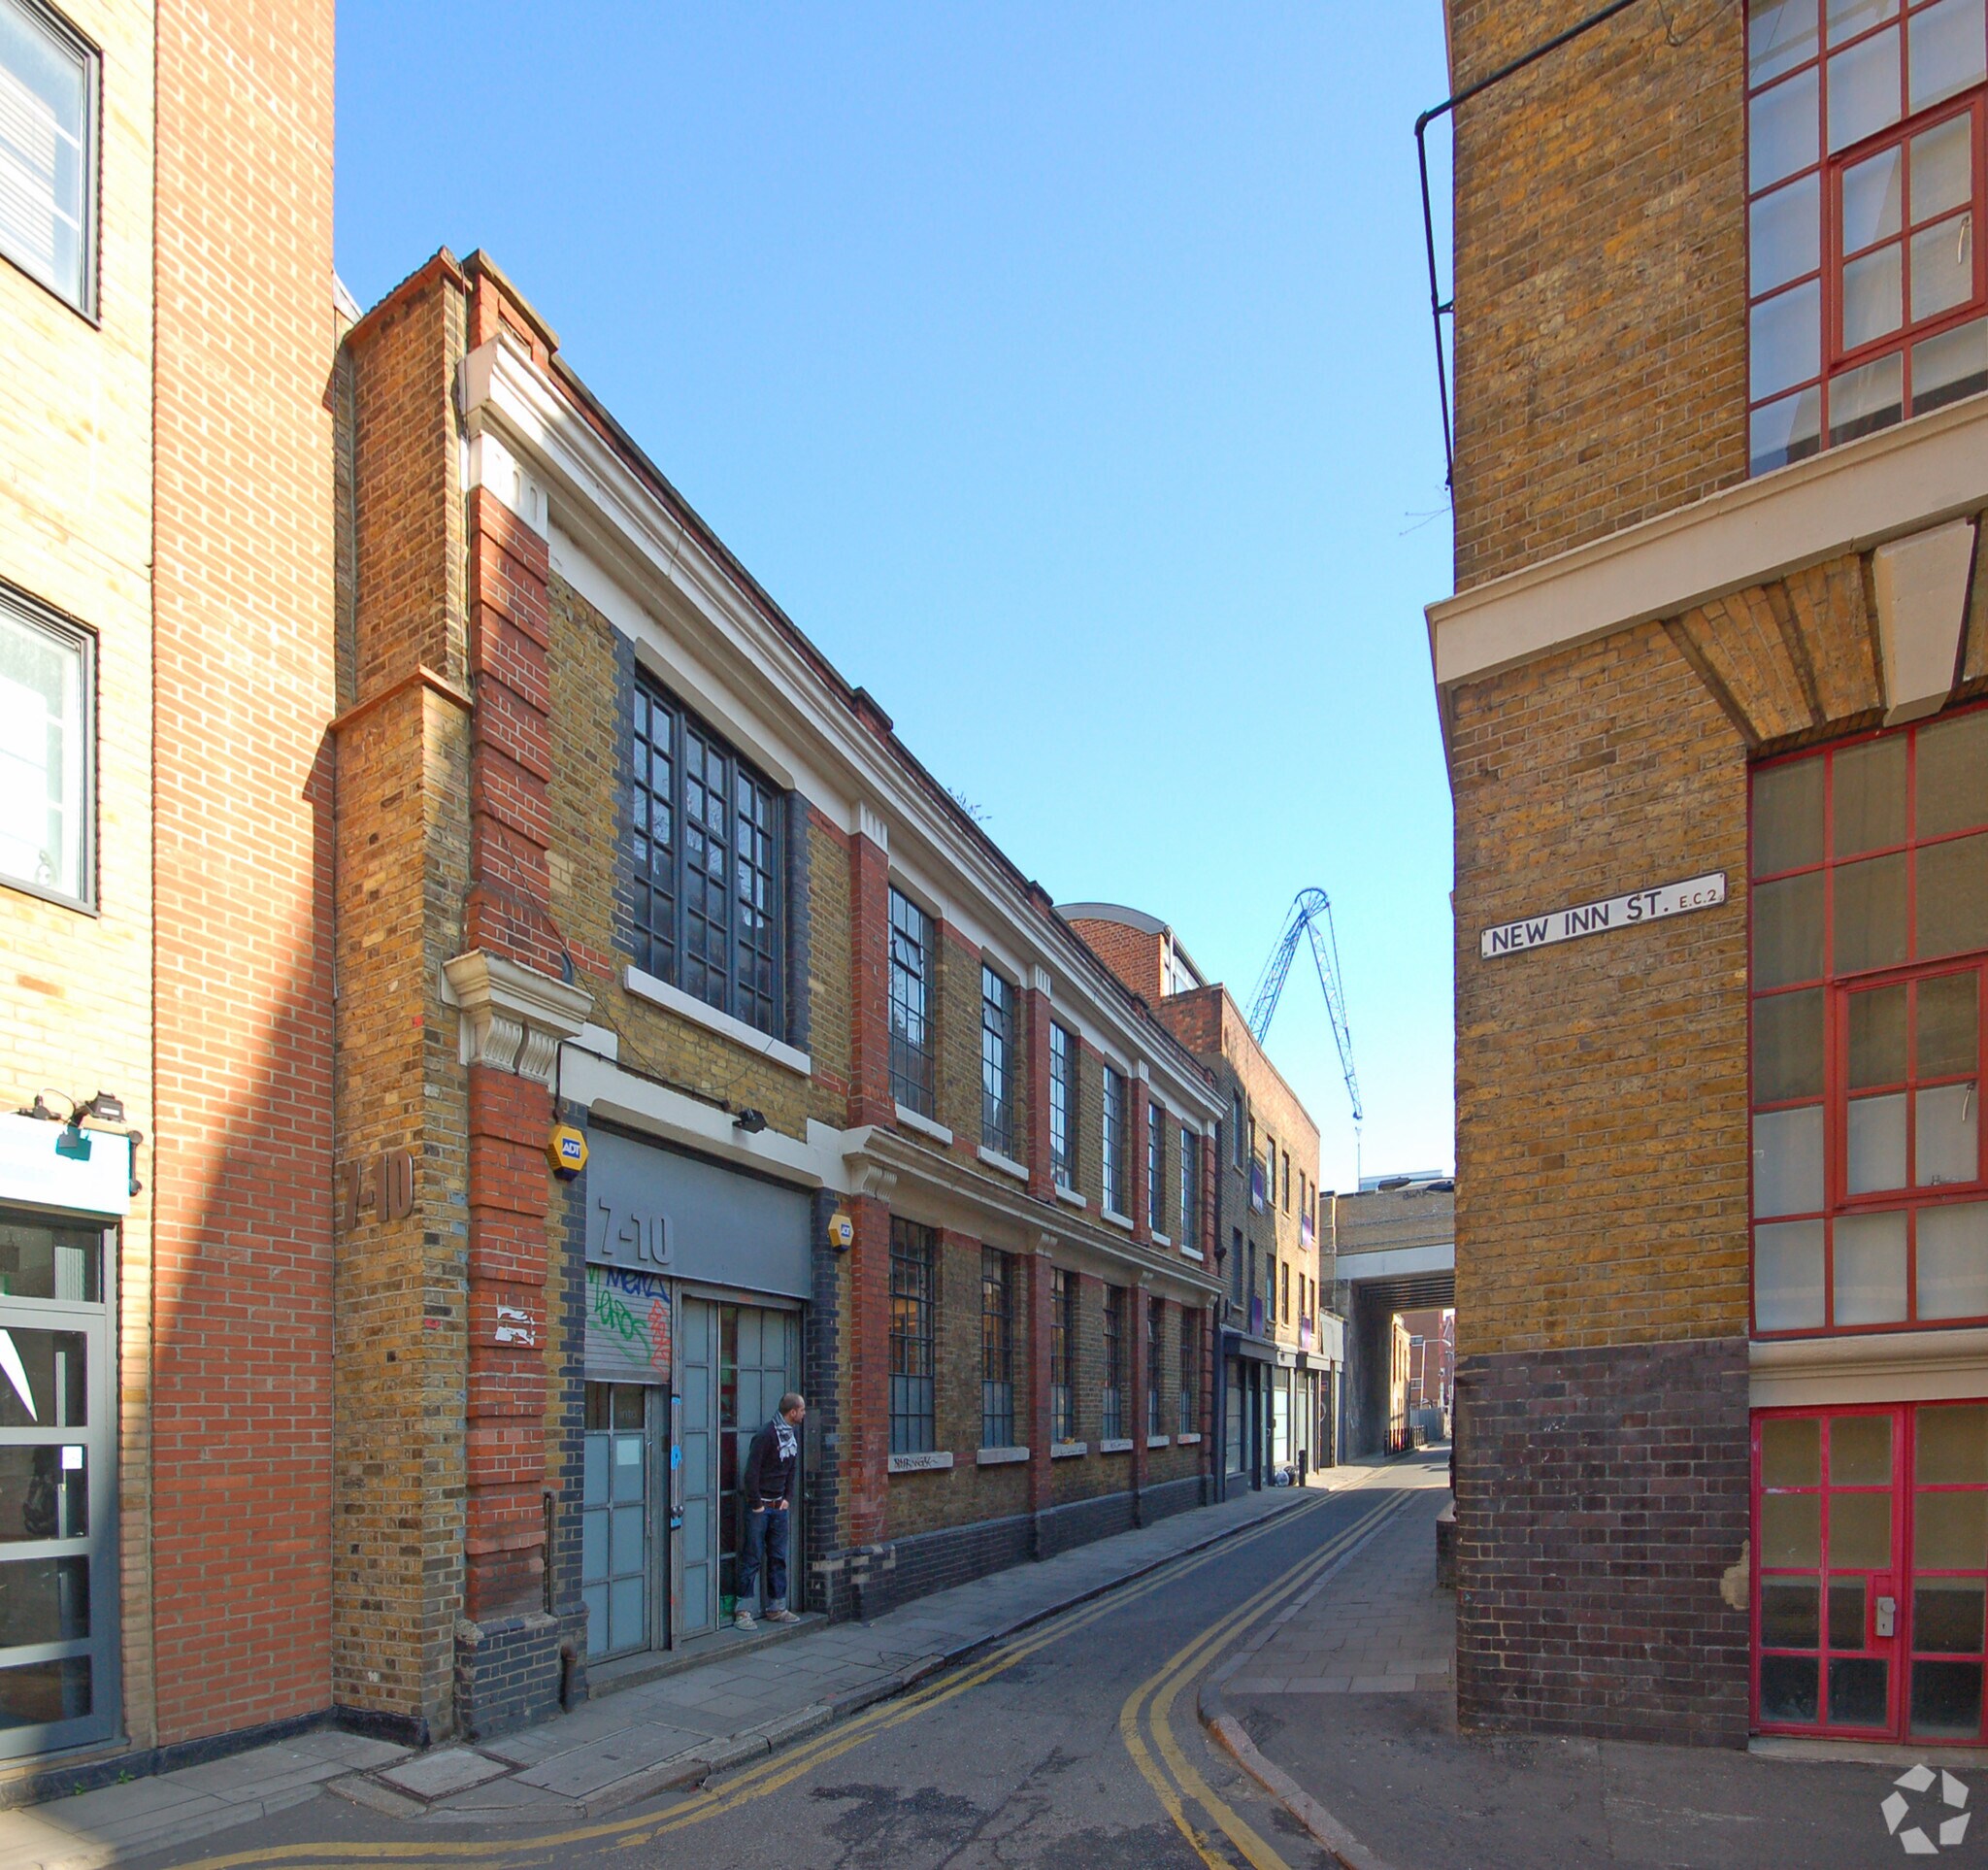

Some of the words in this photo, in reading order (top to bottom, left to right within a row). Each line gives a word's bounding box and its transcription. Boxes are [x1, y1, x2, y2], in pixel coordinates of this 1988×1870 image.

[1492, 918, 1548, 952] NEW
[1565, 904, 1609, 936] INN
[1626, 891, 1669, 920] ST.
[562, 1140, 580, 1156] ADT
[334, 1150, 414, 1228] 7-10
[599, 1196, 674, 1265] 7-10
